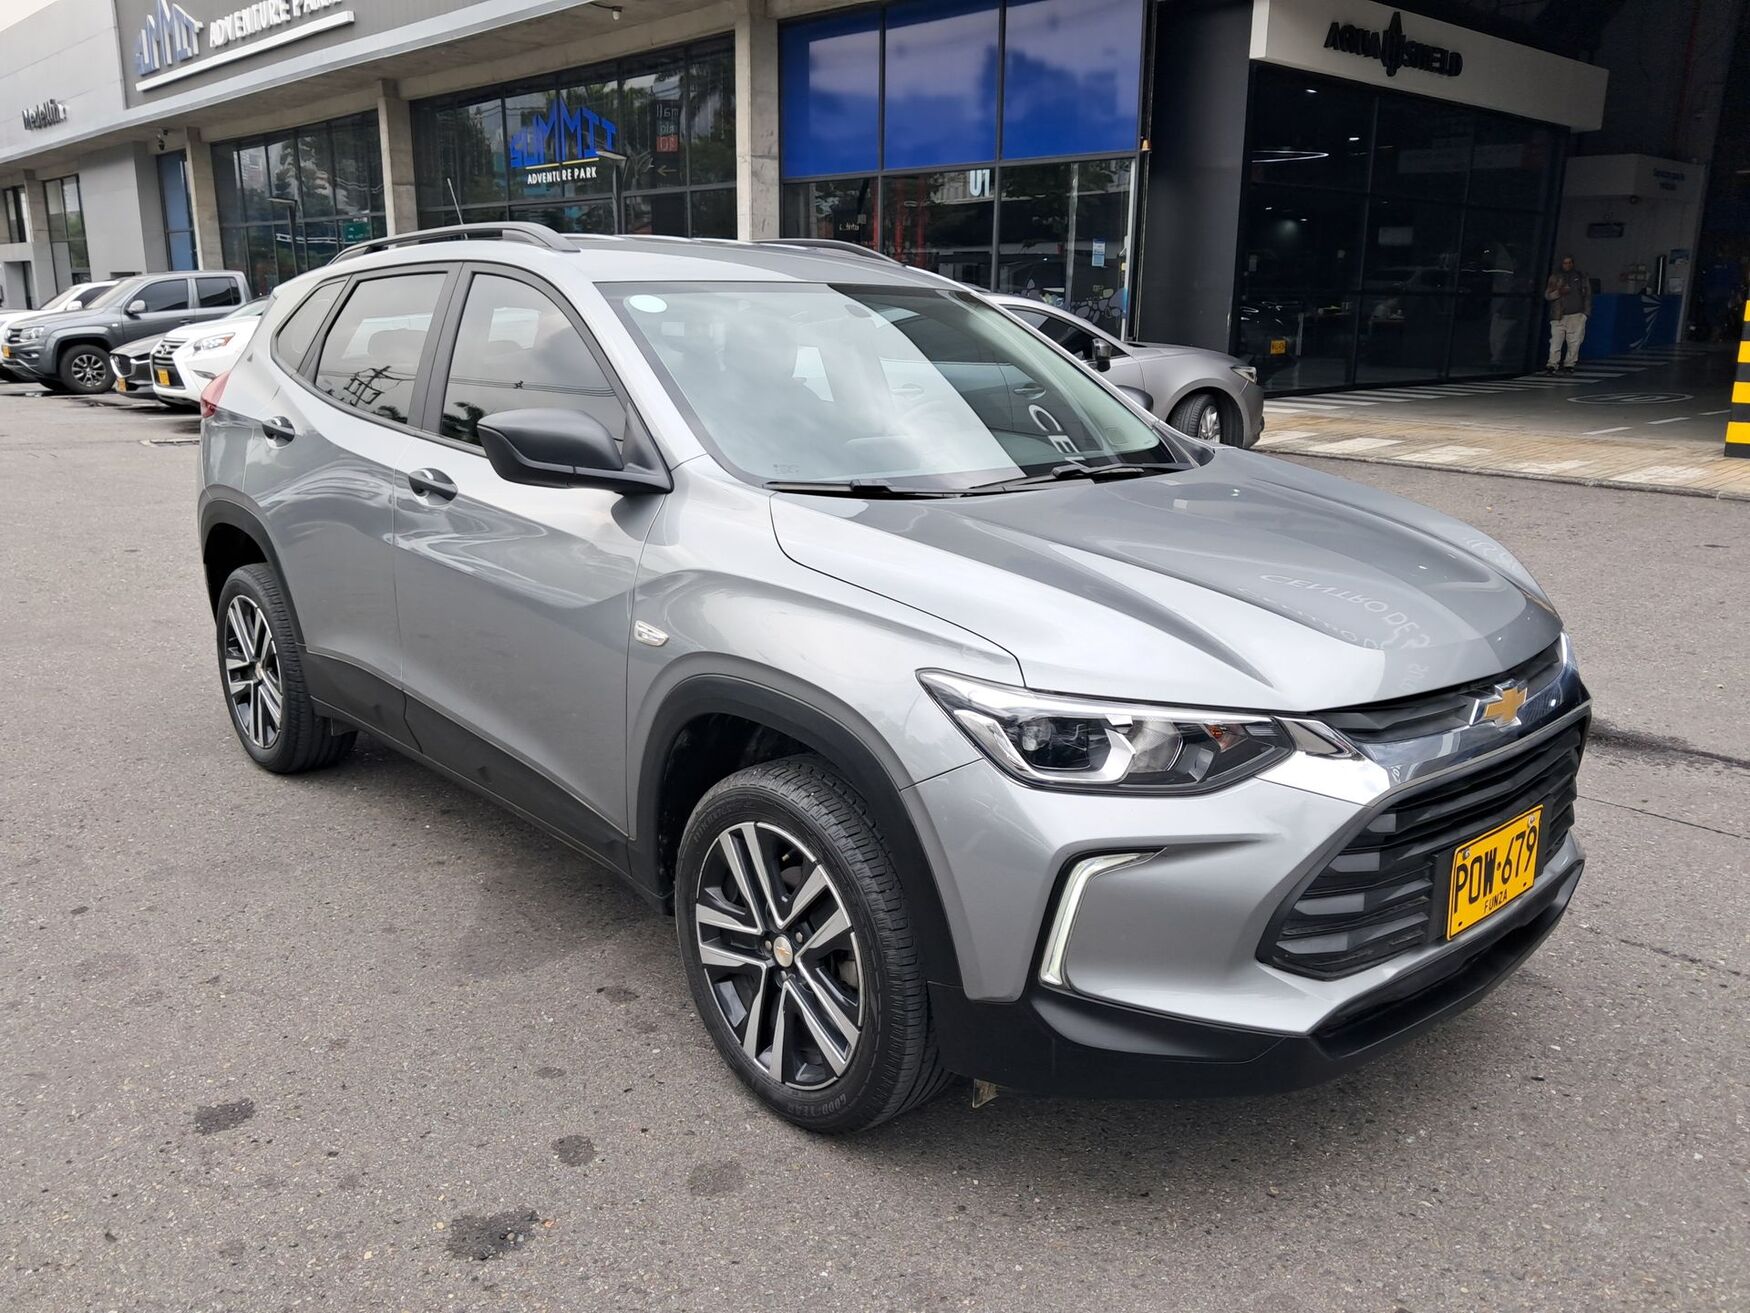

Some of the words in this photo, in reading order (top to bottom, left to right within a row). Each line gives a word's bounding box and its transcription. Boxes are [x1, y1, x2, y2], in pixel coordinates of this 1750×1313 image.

[209, 0, 291, 48] ADVENTURE
[527, 169, 572, 185] ADVENTURE
[573, 166, 597, 180] PARK
[1484, 889, 1508, 914] FUNZA
